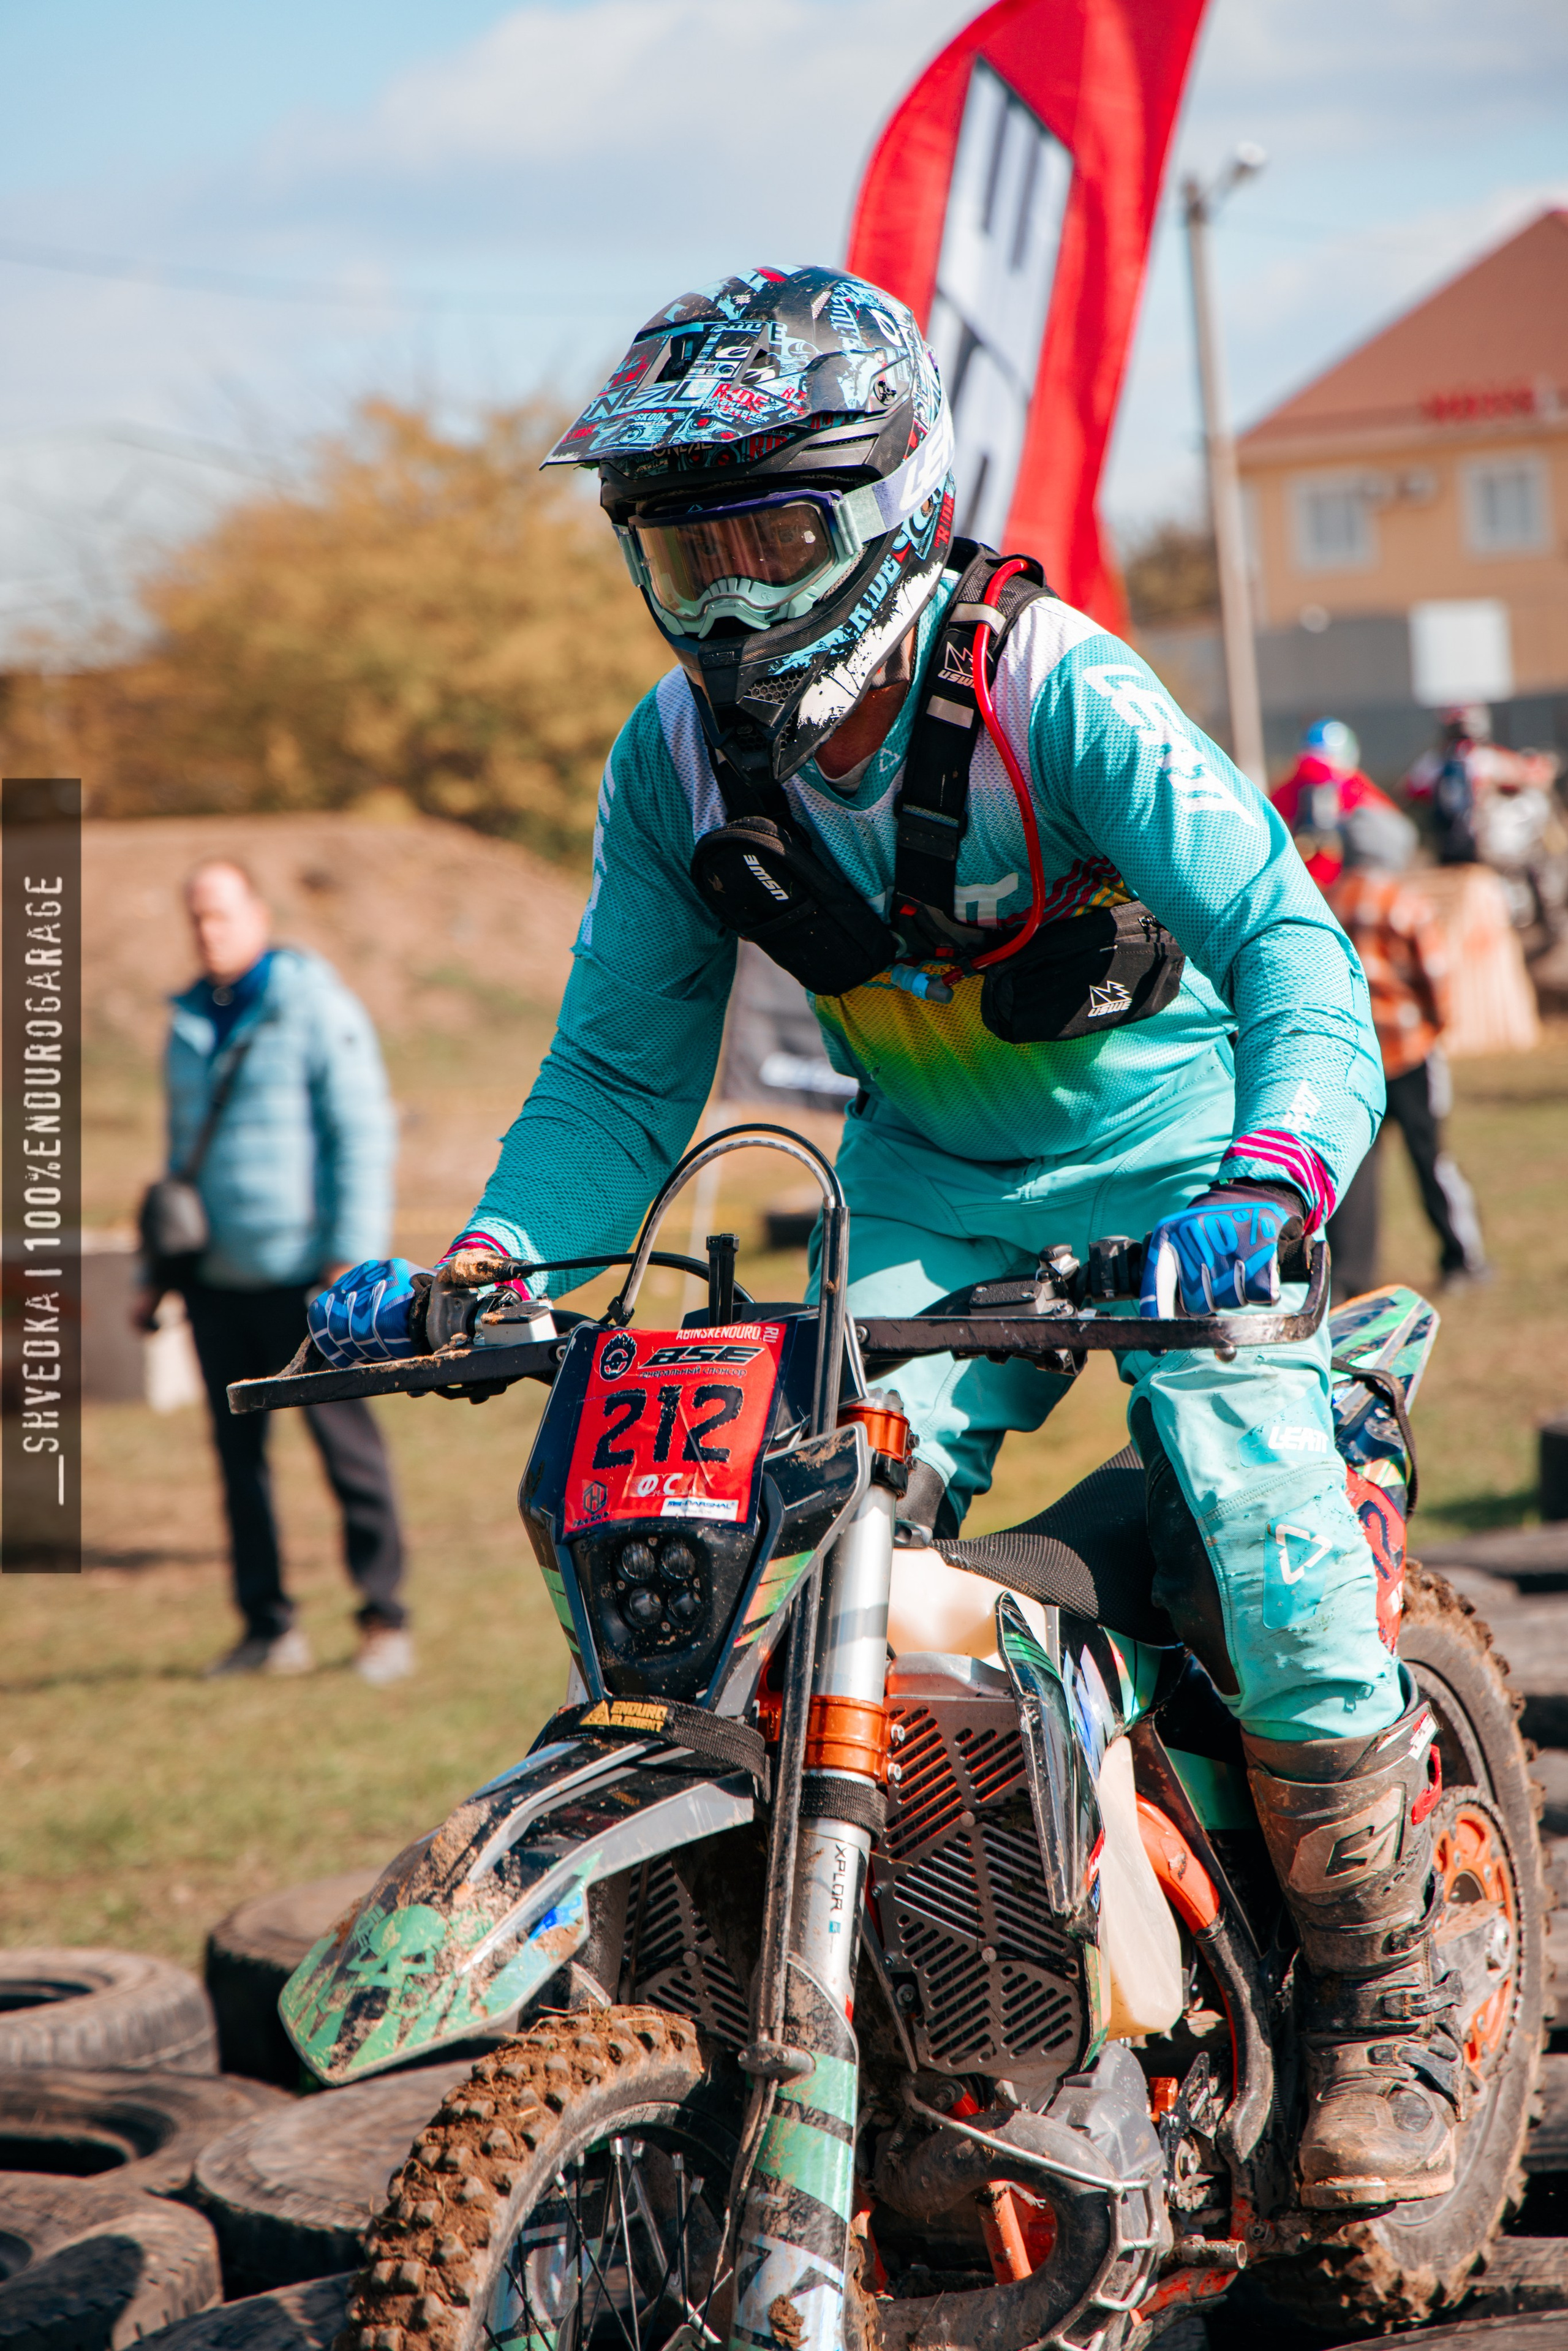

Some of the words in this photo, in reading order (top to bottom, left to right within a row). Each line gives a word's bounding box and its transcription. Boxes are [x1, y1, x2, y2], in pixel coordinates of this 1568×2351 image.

[743, 855, 789, 900] USWE
[1088, 1000, 1133, 1017] USWE
[1169, 1207, 1276, 1282] 100%
[703, 1366, 747, 1377] спонсор
[592, 1383, 745, 1470] 212
[1268, 1425, 1330, 1454] LEATT
[609, 1714, 665, 1733] ELEMENT
[610, 1700, 668, 1721] ENDURO
[829, 1844, 848, 1912] XPLOR
